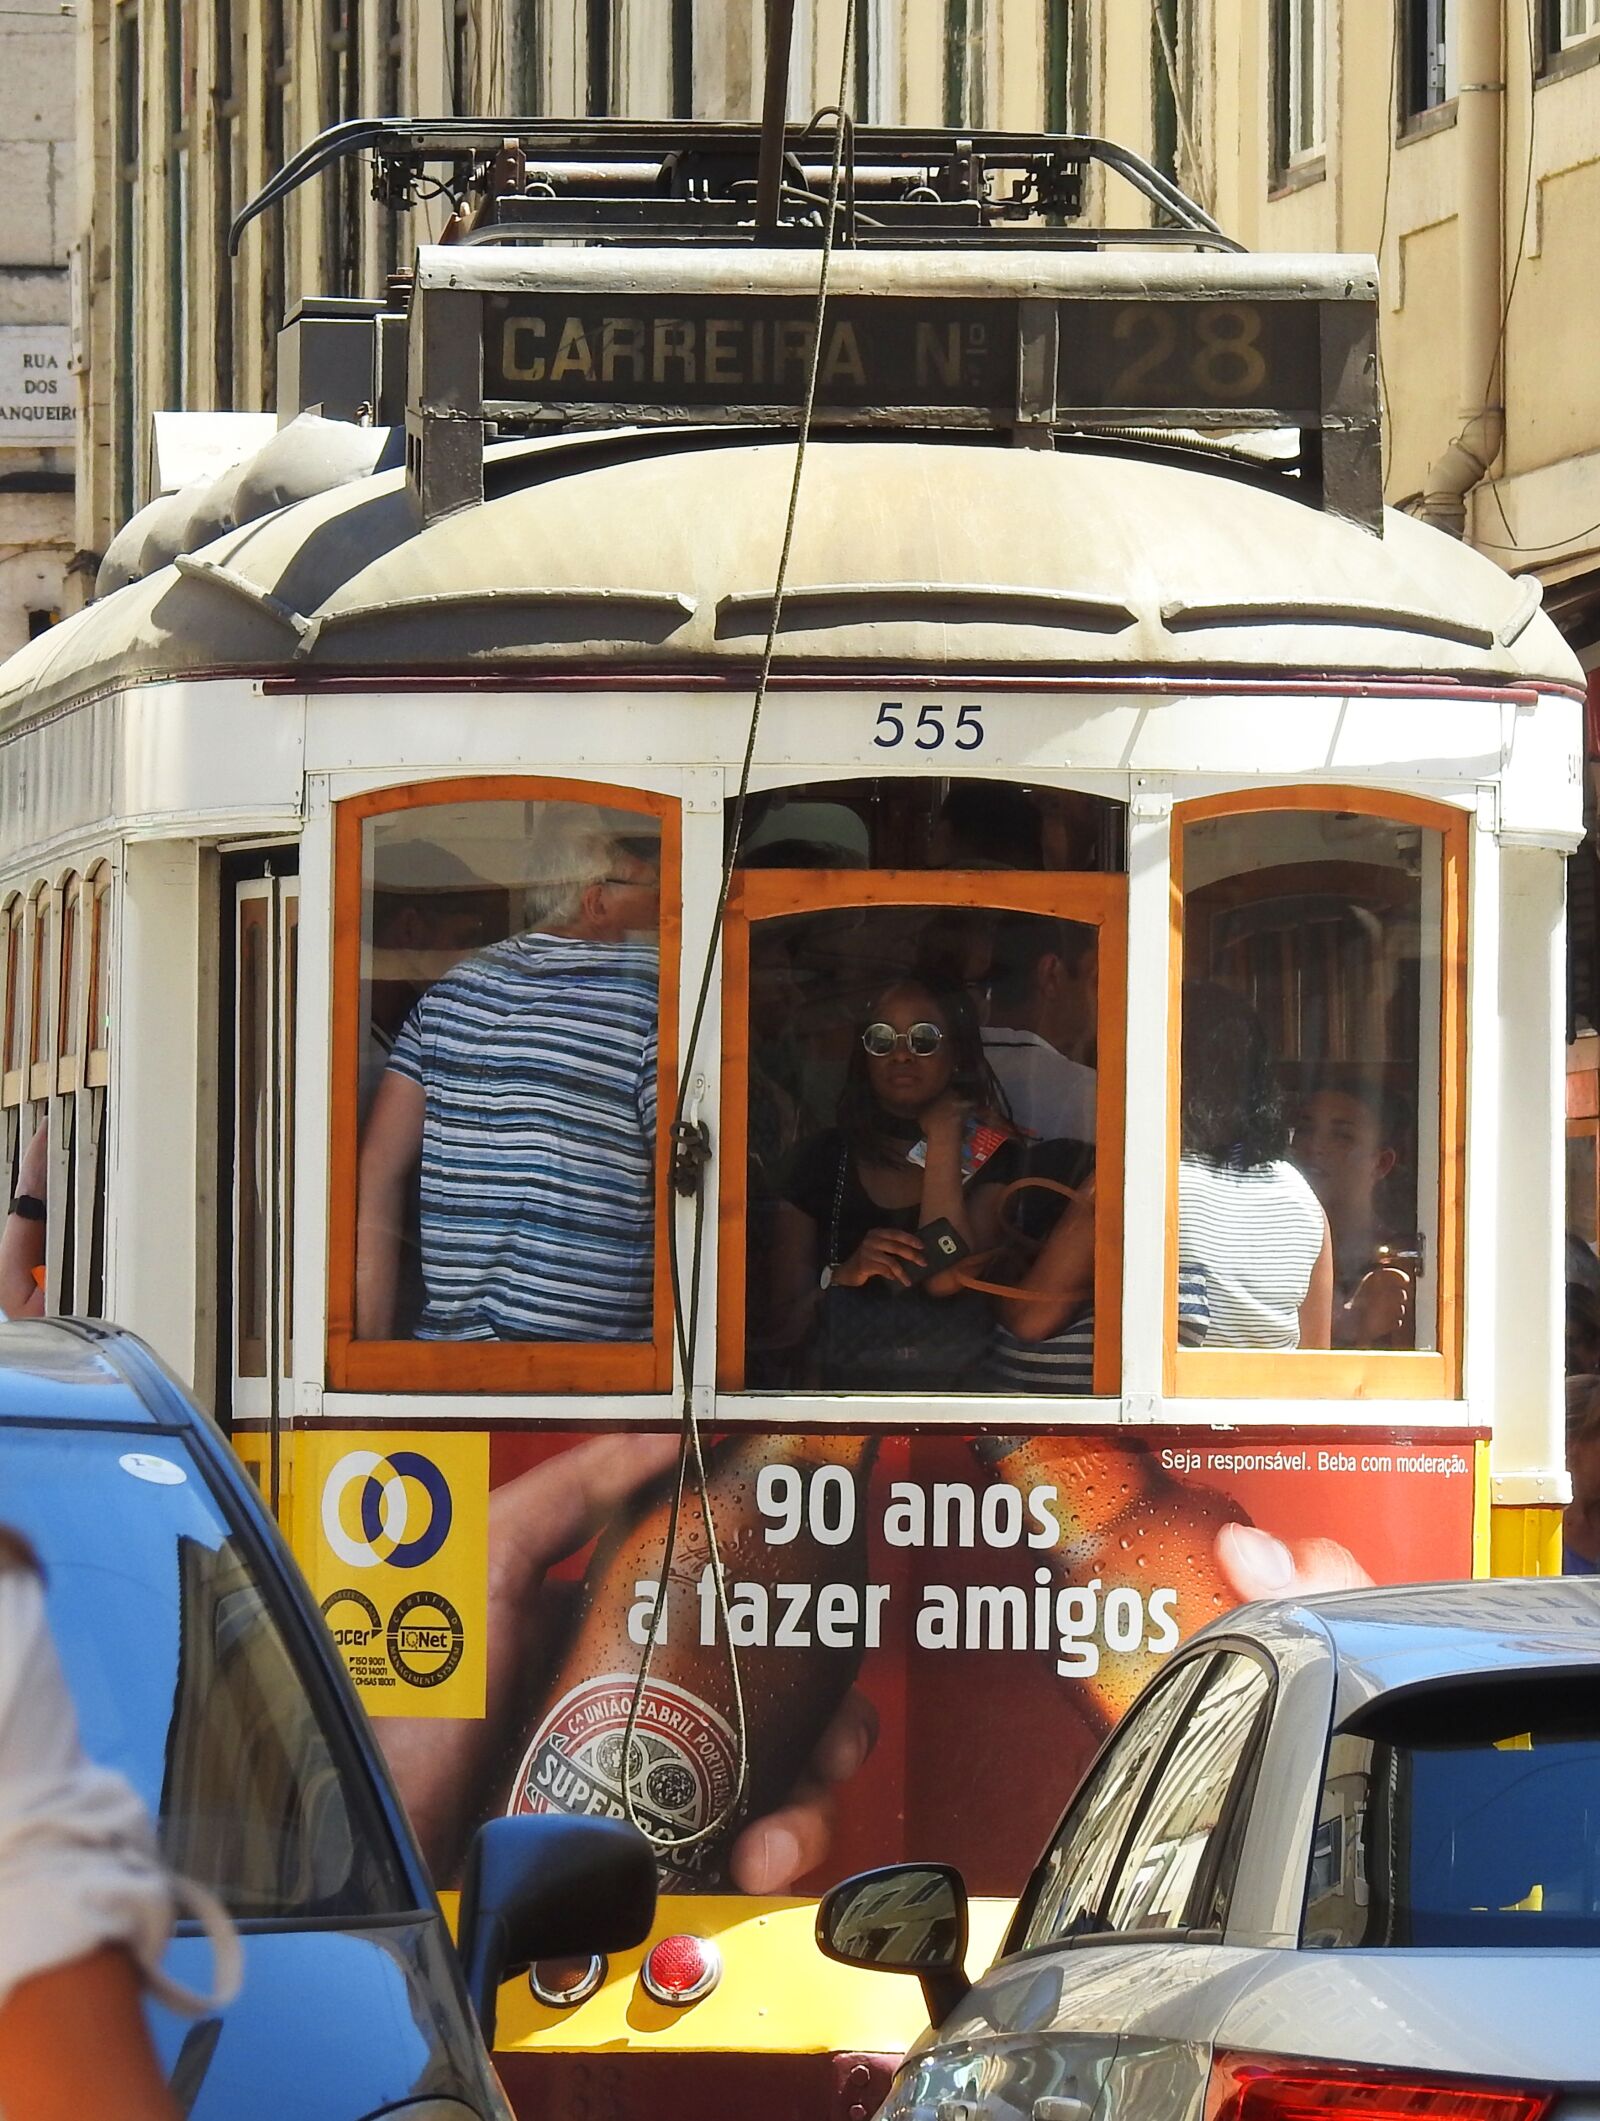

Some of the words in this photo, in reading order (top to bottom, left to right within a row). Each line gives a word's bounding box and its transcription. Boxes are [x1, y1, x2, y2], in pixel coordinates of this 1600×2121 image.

[23, 354, 58, 369] RUA
[502, 317, 868, 386] CARREIRA
[1107, 303, 1266, 402] 28
[24, 380, 58, 394] DOS
[873, 702, 984, 750] 555
[1161, 1449, 1201, 1473] Seja
[1207, 1451, 1312, 1474] responsável.
[1318, 1451, 1357, 1473] Beba
[1361, 1456, 1392, 1473] com
[1397, 1454, 1469, 1478] moderação.
[756, 1464, 856, 1546] 90
[883, 1482, 1060, 1549] anos
[401, 1631, 448, 1650] IQNet
[627, 1579, 669, 1646] a
[697, 1563, 890, 1648] fazer
[915, 1567, 1180, 1678] amigos
[583, 1695, 632, 1724] UNIÃO
[637, 1699, 695, 1737] FABRIL
